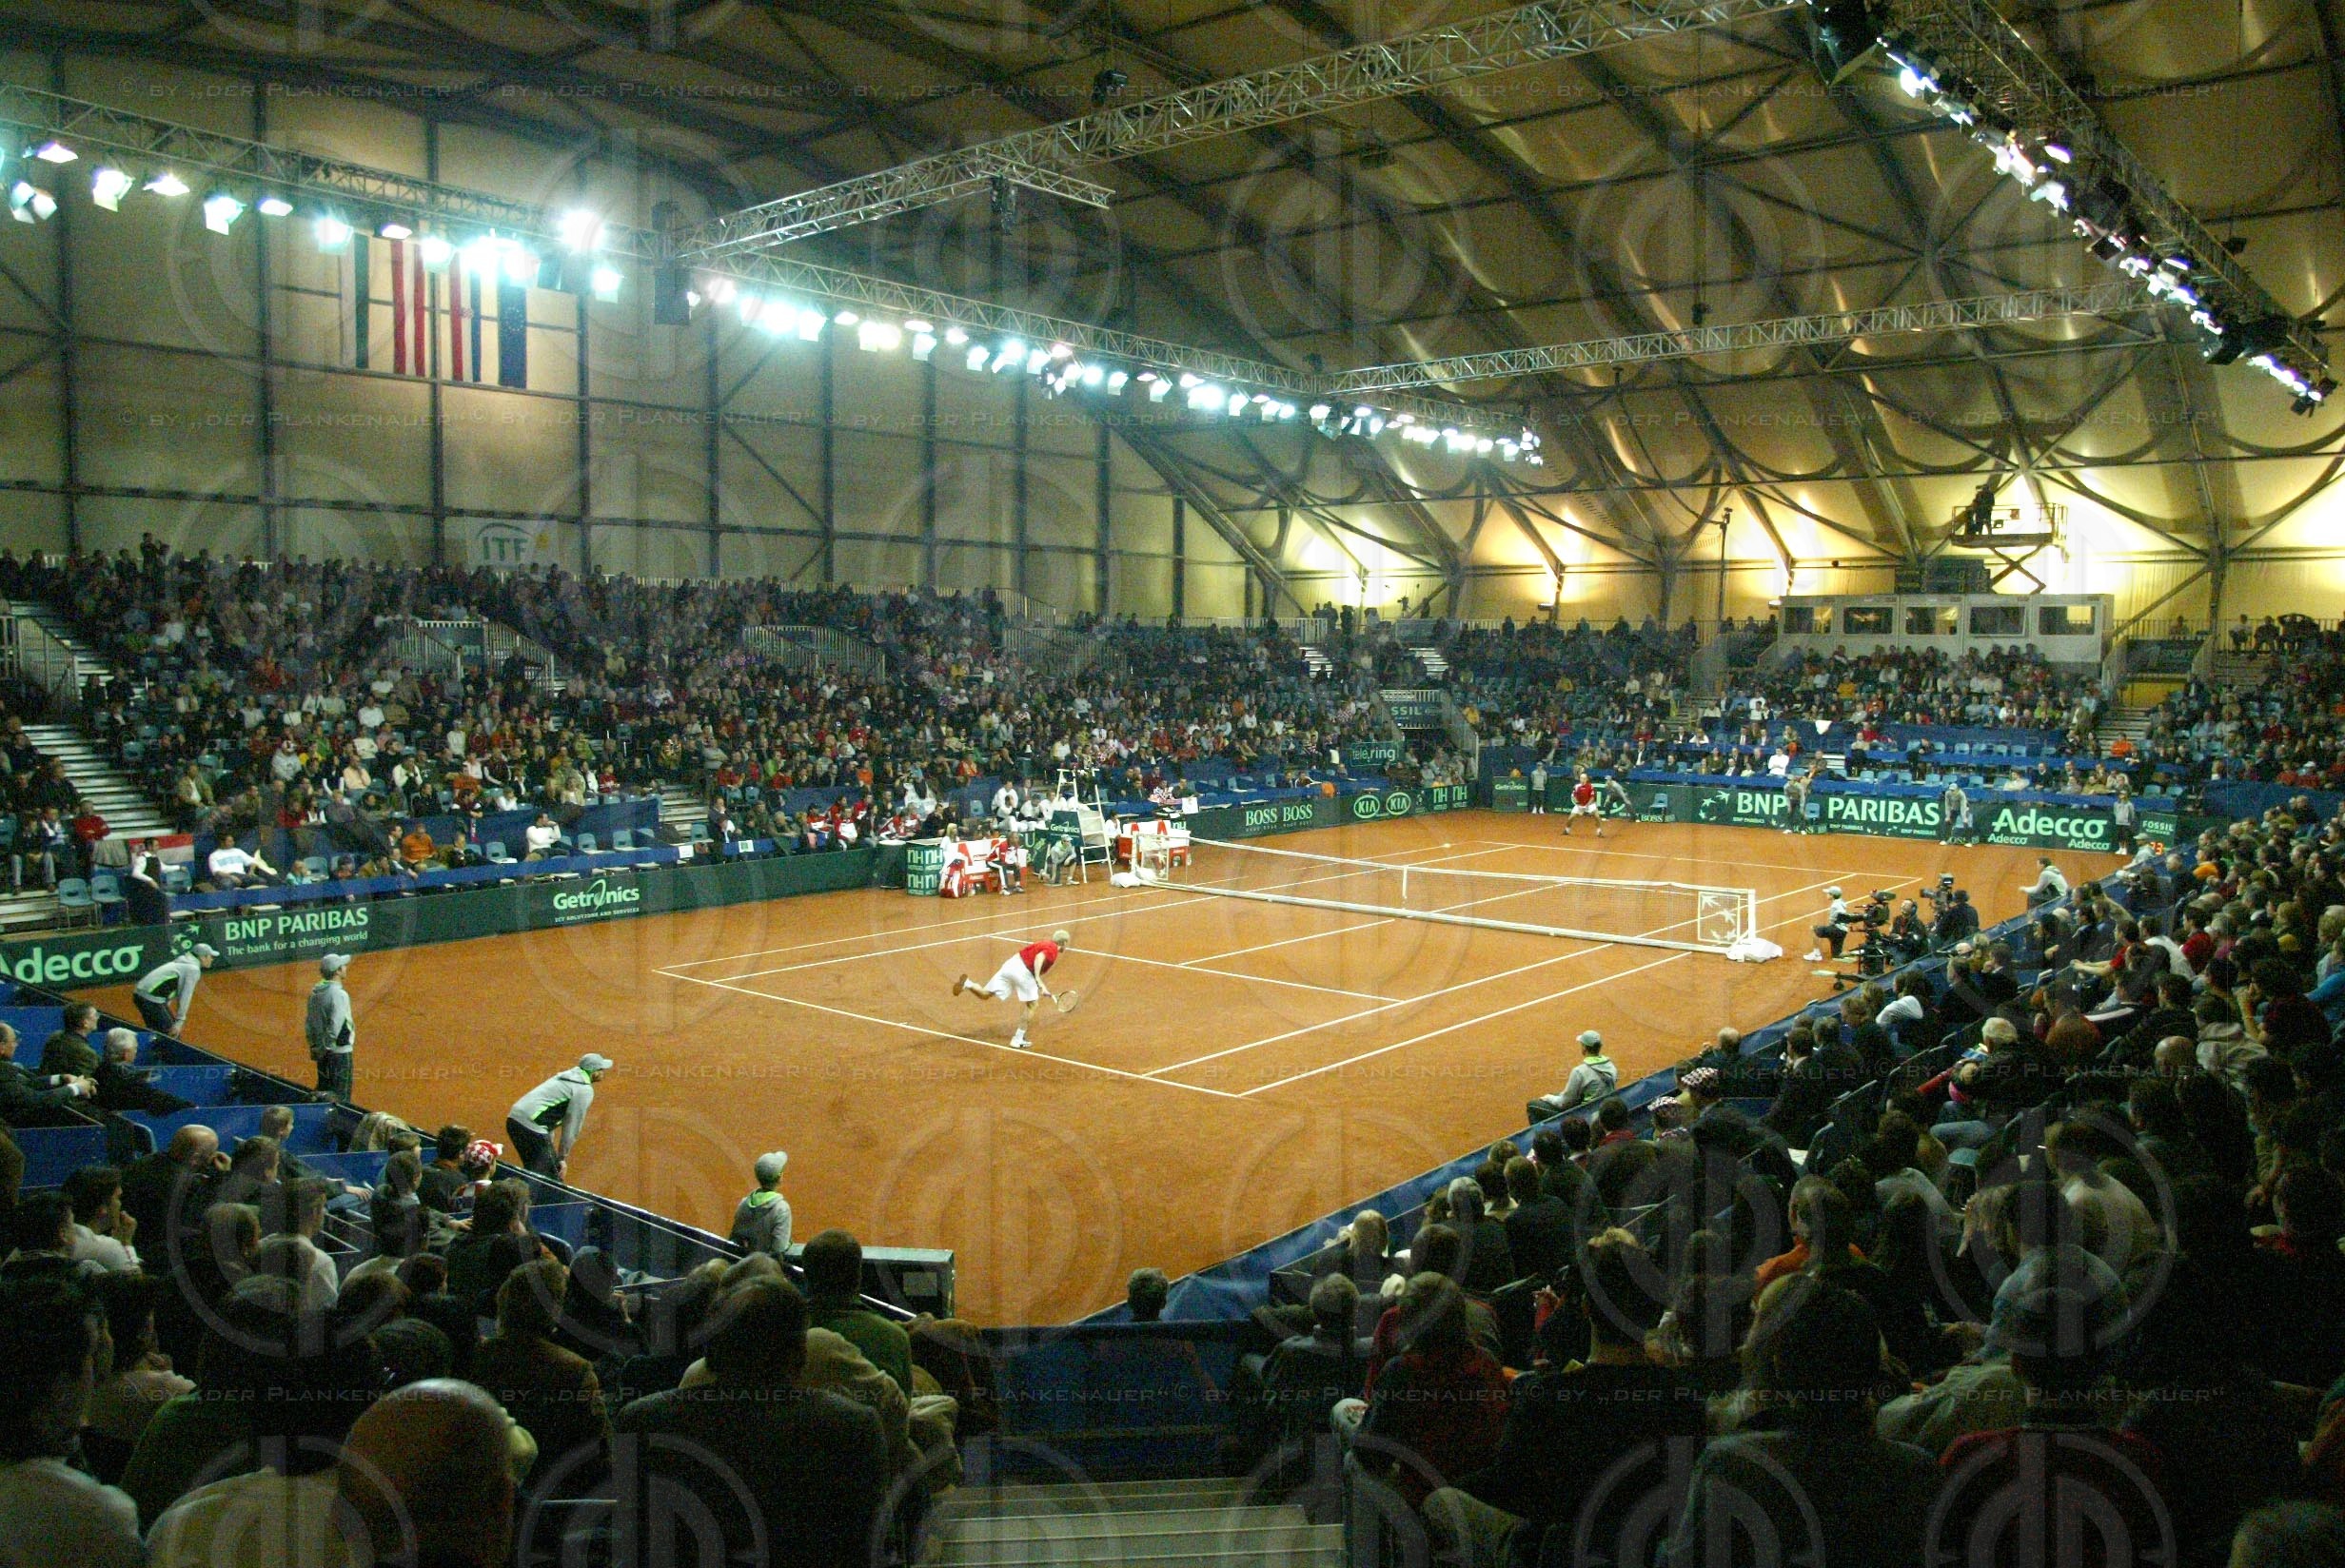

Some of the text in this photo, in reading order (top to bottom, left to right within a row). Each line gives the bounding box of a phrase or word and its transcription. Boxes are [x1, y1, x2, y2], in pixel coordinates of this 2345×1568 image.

[483, 537, 527, 561] ITF
[1390, 705, 1422, 715] SSIL
[1246, 808, 1277, 826] BOSS
[1283, 803, 1313, 821] BOSS
[1358, 800, 1376, 813] KIA
[1390, 797, 1408, 810] KIA
[1737, 793, 1940, 826] BNP PARIBAS
[1991, 808, 2108, 838] Adecco
[2142, 820, 2174, 832] FOSSIL
[1987, 833, 2028, 845] Adecco
[2067, 838, 2110, 851] Adecco
[553, 878, 640, 911] Getronics
[225, 907, 369, 941] BNP PARIBAS
[227, 931, 368, 956] The bank for a changing world
